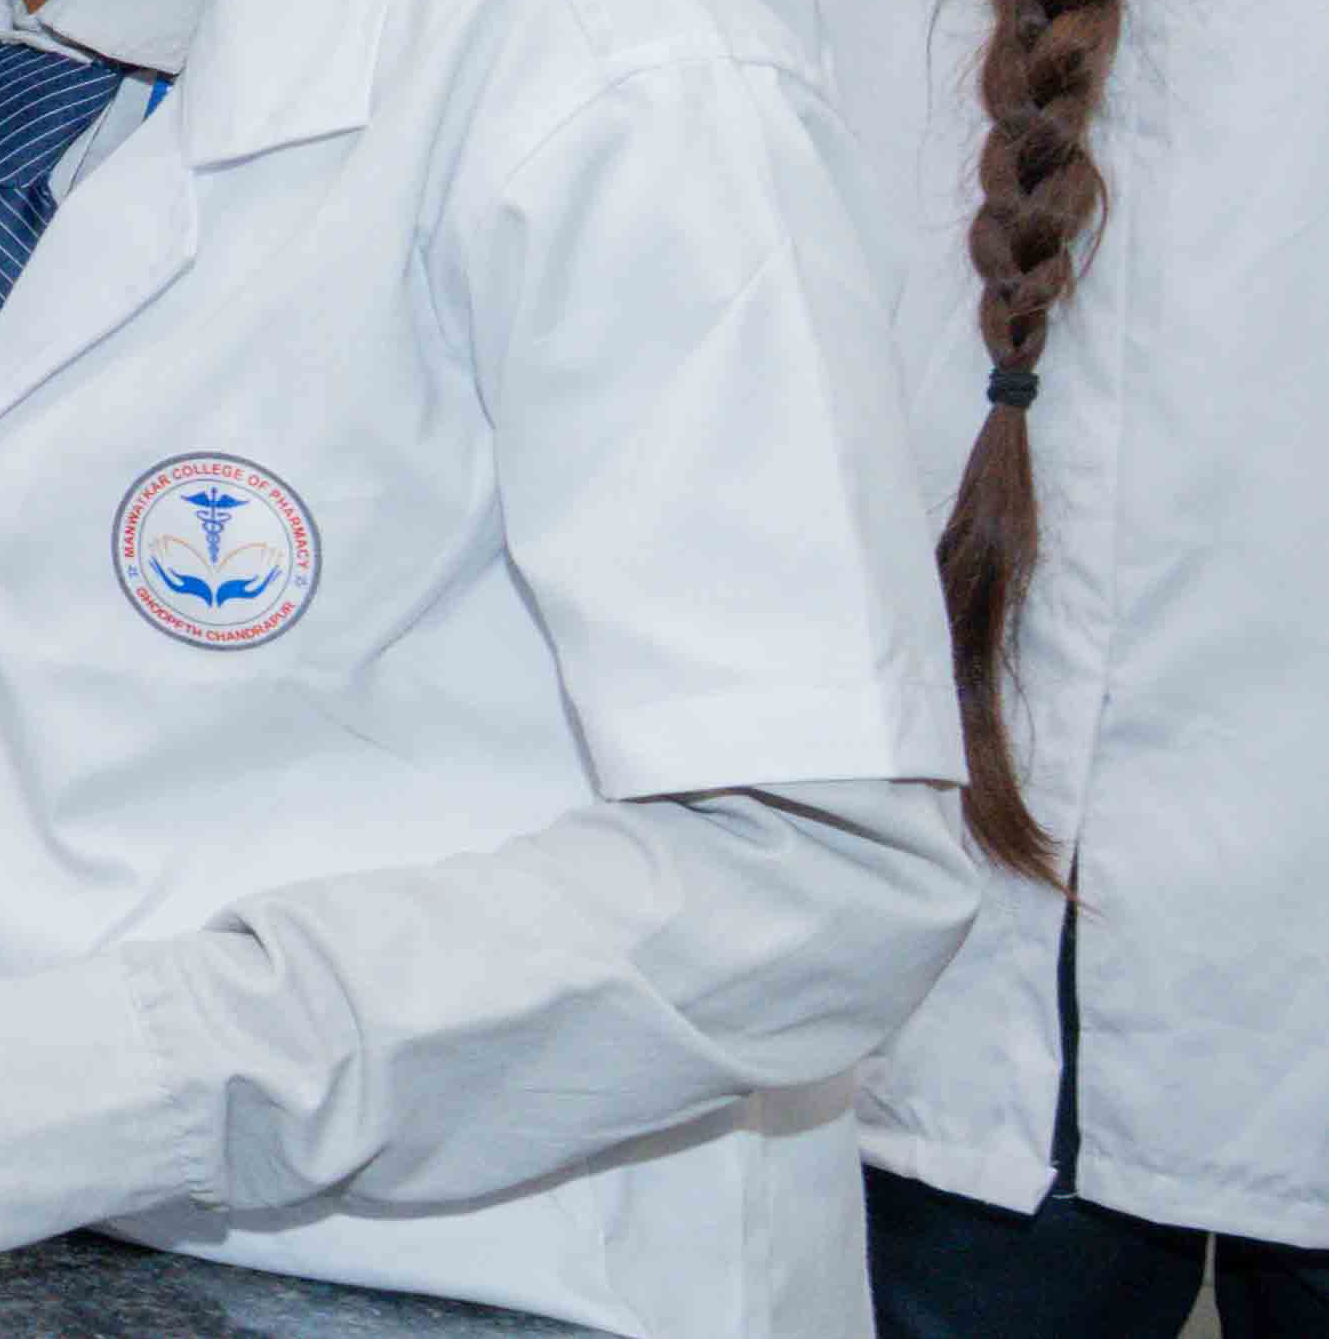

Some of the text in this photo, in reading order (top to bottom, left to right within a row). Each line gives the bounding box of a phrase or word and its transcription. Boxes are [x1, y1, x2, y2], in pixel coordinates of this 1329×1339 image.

[124, 462, 311, 571] MANWATKAR COLLEGE OF PHARMACY
